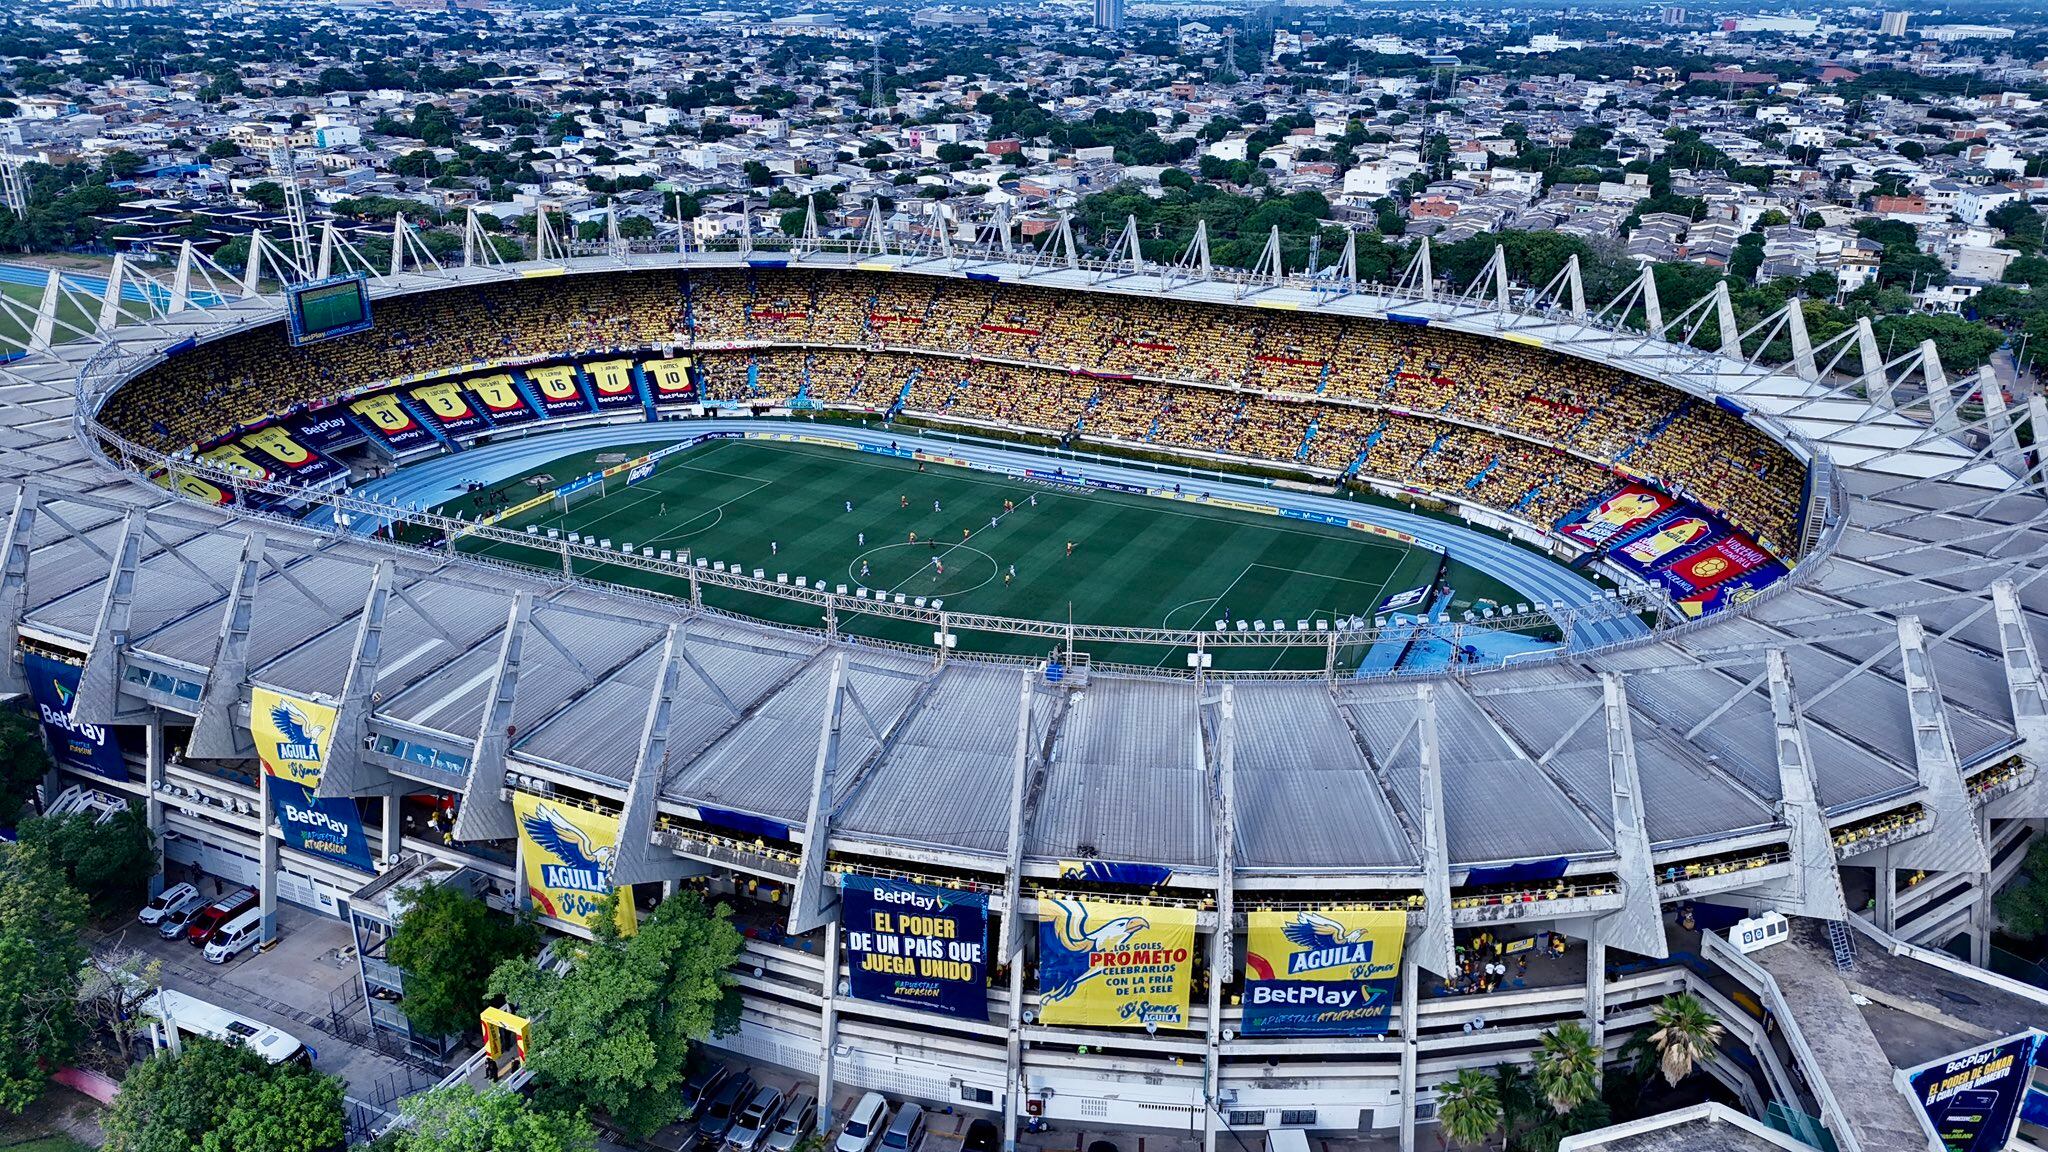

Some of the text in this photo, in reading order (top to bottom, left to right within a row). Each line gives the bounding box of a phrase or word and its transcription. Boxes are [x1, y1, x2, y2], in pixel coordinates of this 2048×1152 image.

[550, 379, 566, 391] 16
[607, 373, 618, 385] 11
[665, 372, 680, 384] 10
[439, 398, 453, 410] 3
[491, 390, 502, 401] 7
[377, 410, 398, 423] 21
[301, 417, 345, 435] BetPlay
[274, 443, 294, 456] 2
[1725, 537, 1767, 564] VIBREMOS
[285, 804, 348, 837] BetPlay
[873, 888, 935, 910] BetPlay
[875, 912, 955, 938] EL PODER
[850, 932, 981, 963] DE UN PAÍS QUE
[1114, 942, 1164, 952] LOS GOLES,
[1090, 948, 1187, 967] PROMETO
[1292, 943, 1367, 973] AGUILA
[861, 953, 972, 981] JUEGA UNIDO
[1103, 964, 1176, 976] CELEBRARLOS
[1106, 973, 1173, 986] CON LA FRÍA
[1116, 985, 1173, 996] DE LA SELE
[1253, 985, 1357, 1007] BetPlay
[1143, 1014, 1178, 1023] AGUILA
[1946, 1051, 1992, 1074] BetPlay
[1929, 1055, 2015, 1097] EL PODER DE GANAR
[1926, 1096, 1937, 1107] EN
[1973, 1067, 2011, 1088] MOMENTO
